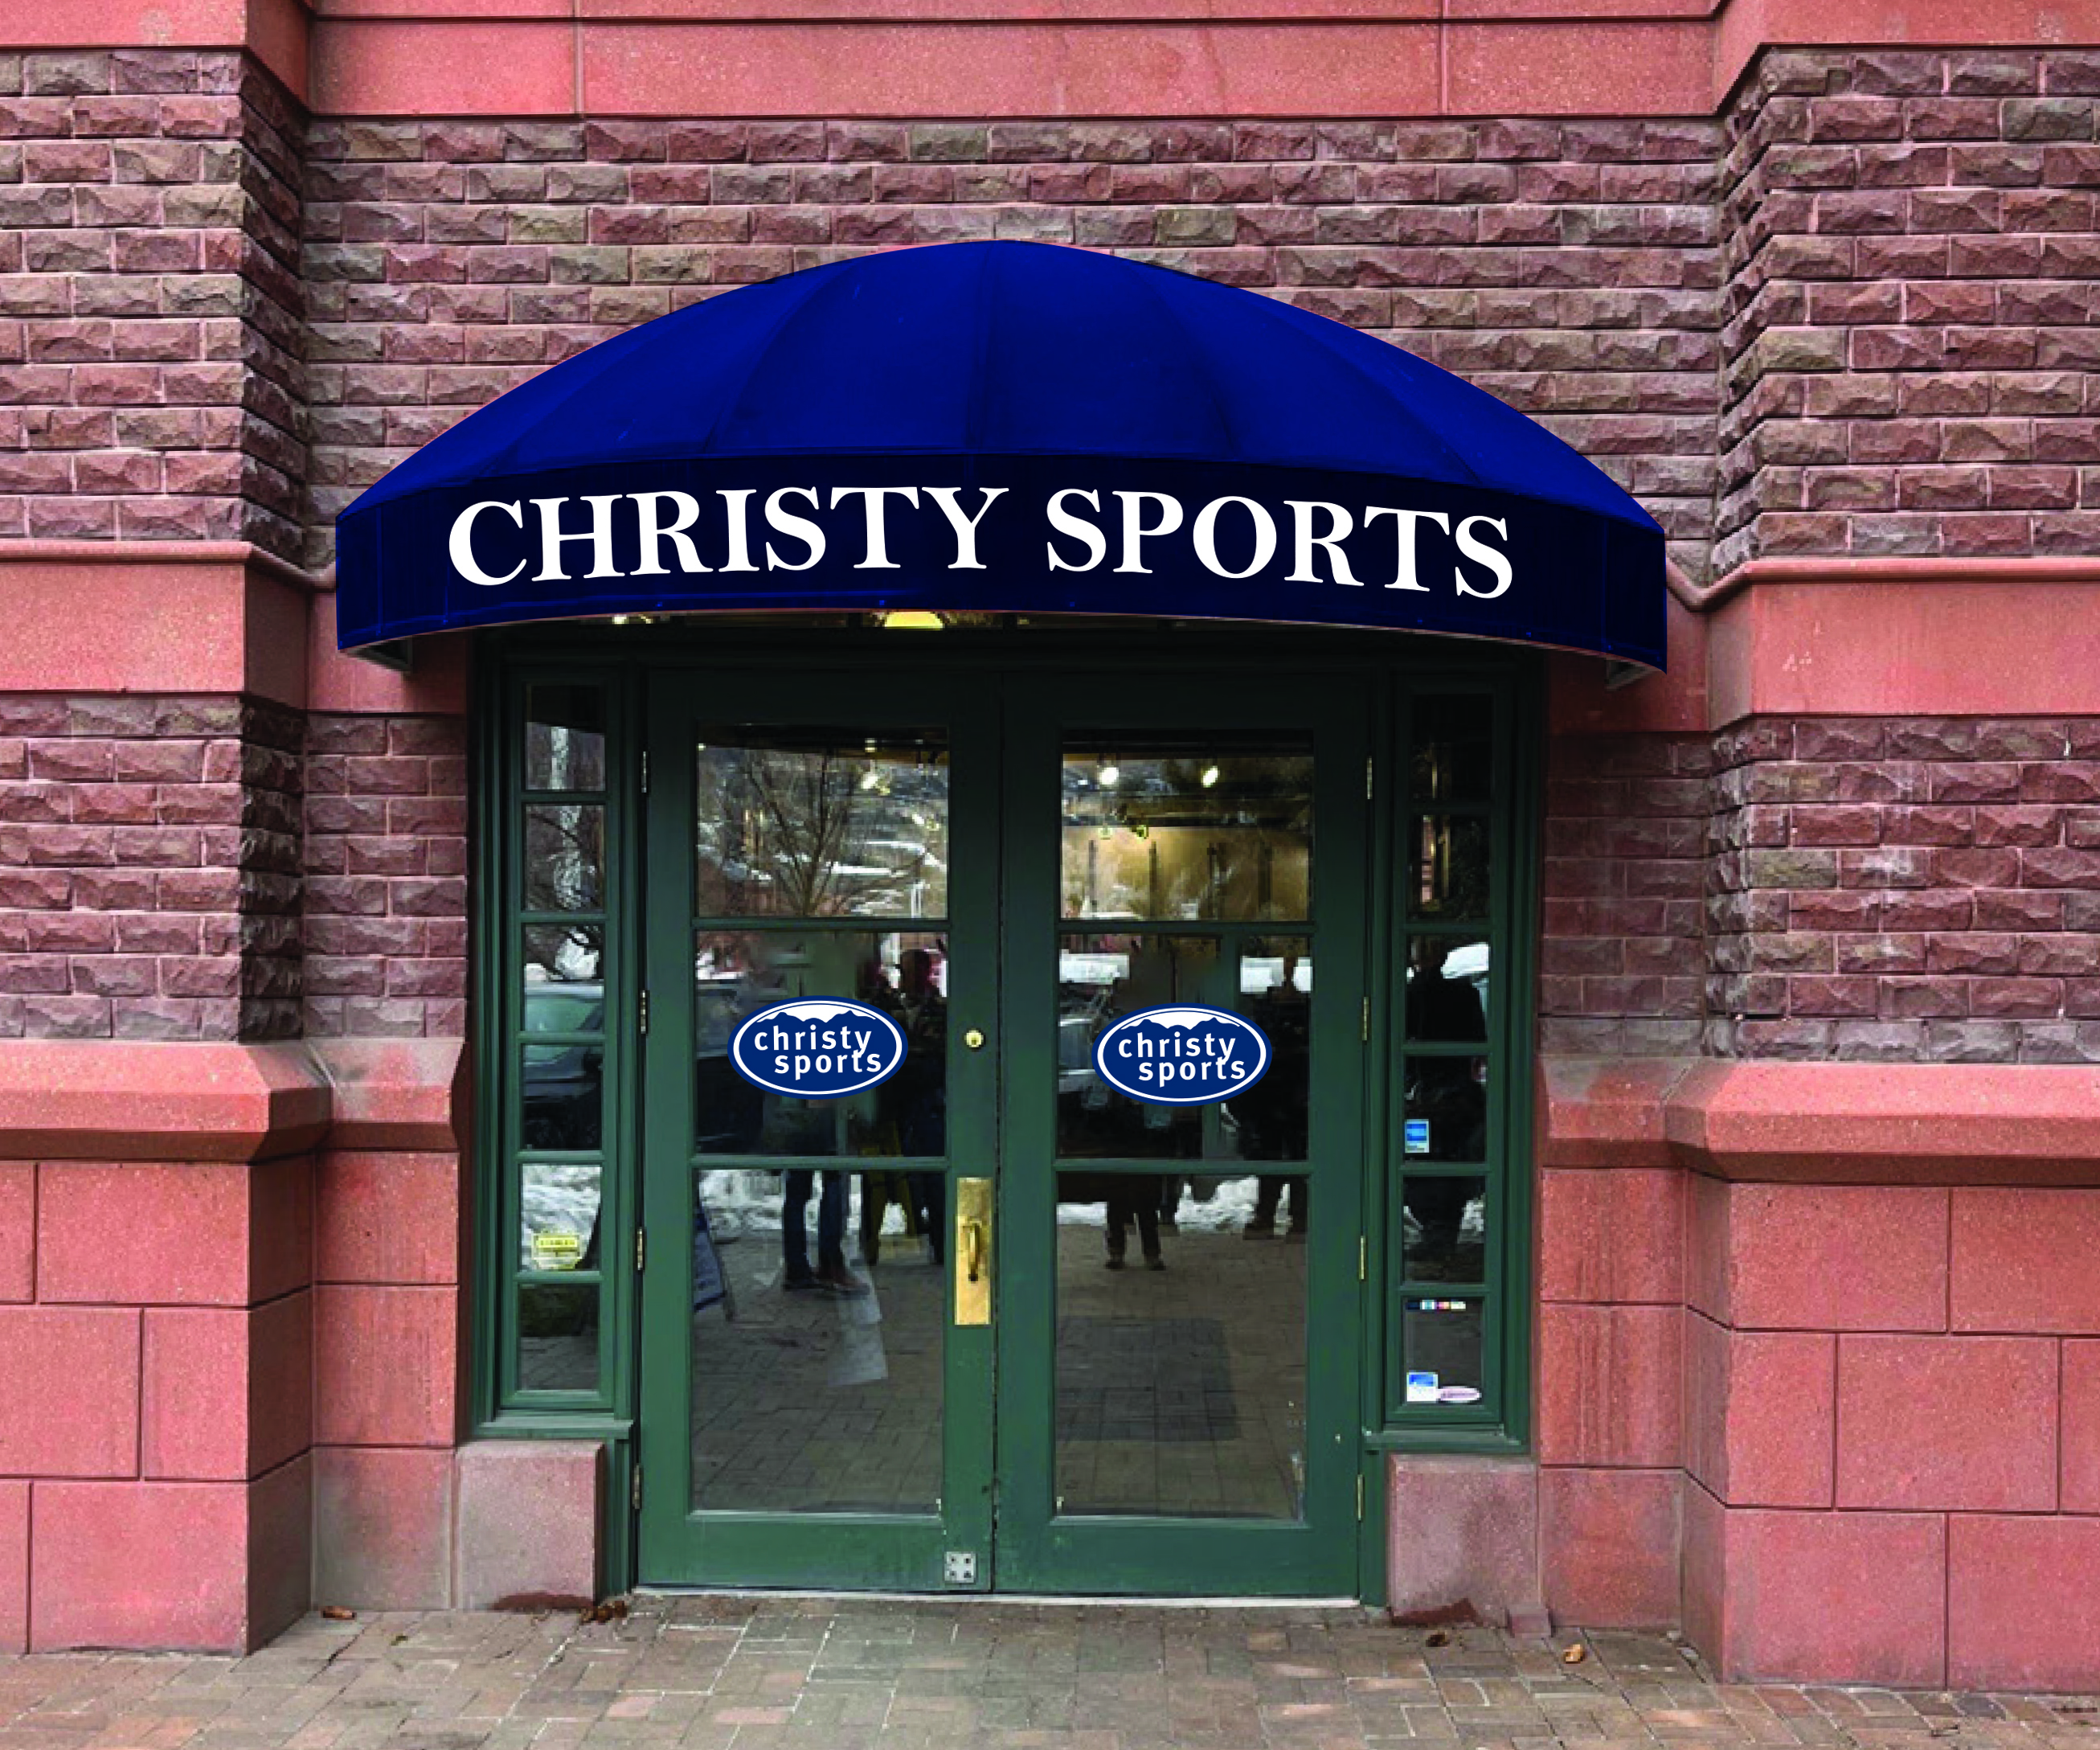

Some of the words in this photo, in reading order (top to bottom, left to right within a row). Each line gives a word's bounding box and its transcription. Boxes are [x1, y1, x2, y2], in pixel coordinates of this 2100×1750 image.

[448, 486, 1009, 586] CHRISTY
[1046, 488, 1513, 599] SPORTS
[754, 1024, 872, 1058] christy
[1118, 1031, 1236, 1065] christy
[774, 1049, 882, 1080] sports
[1138, 1055, 1246, 1088] sports
